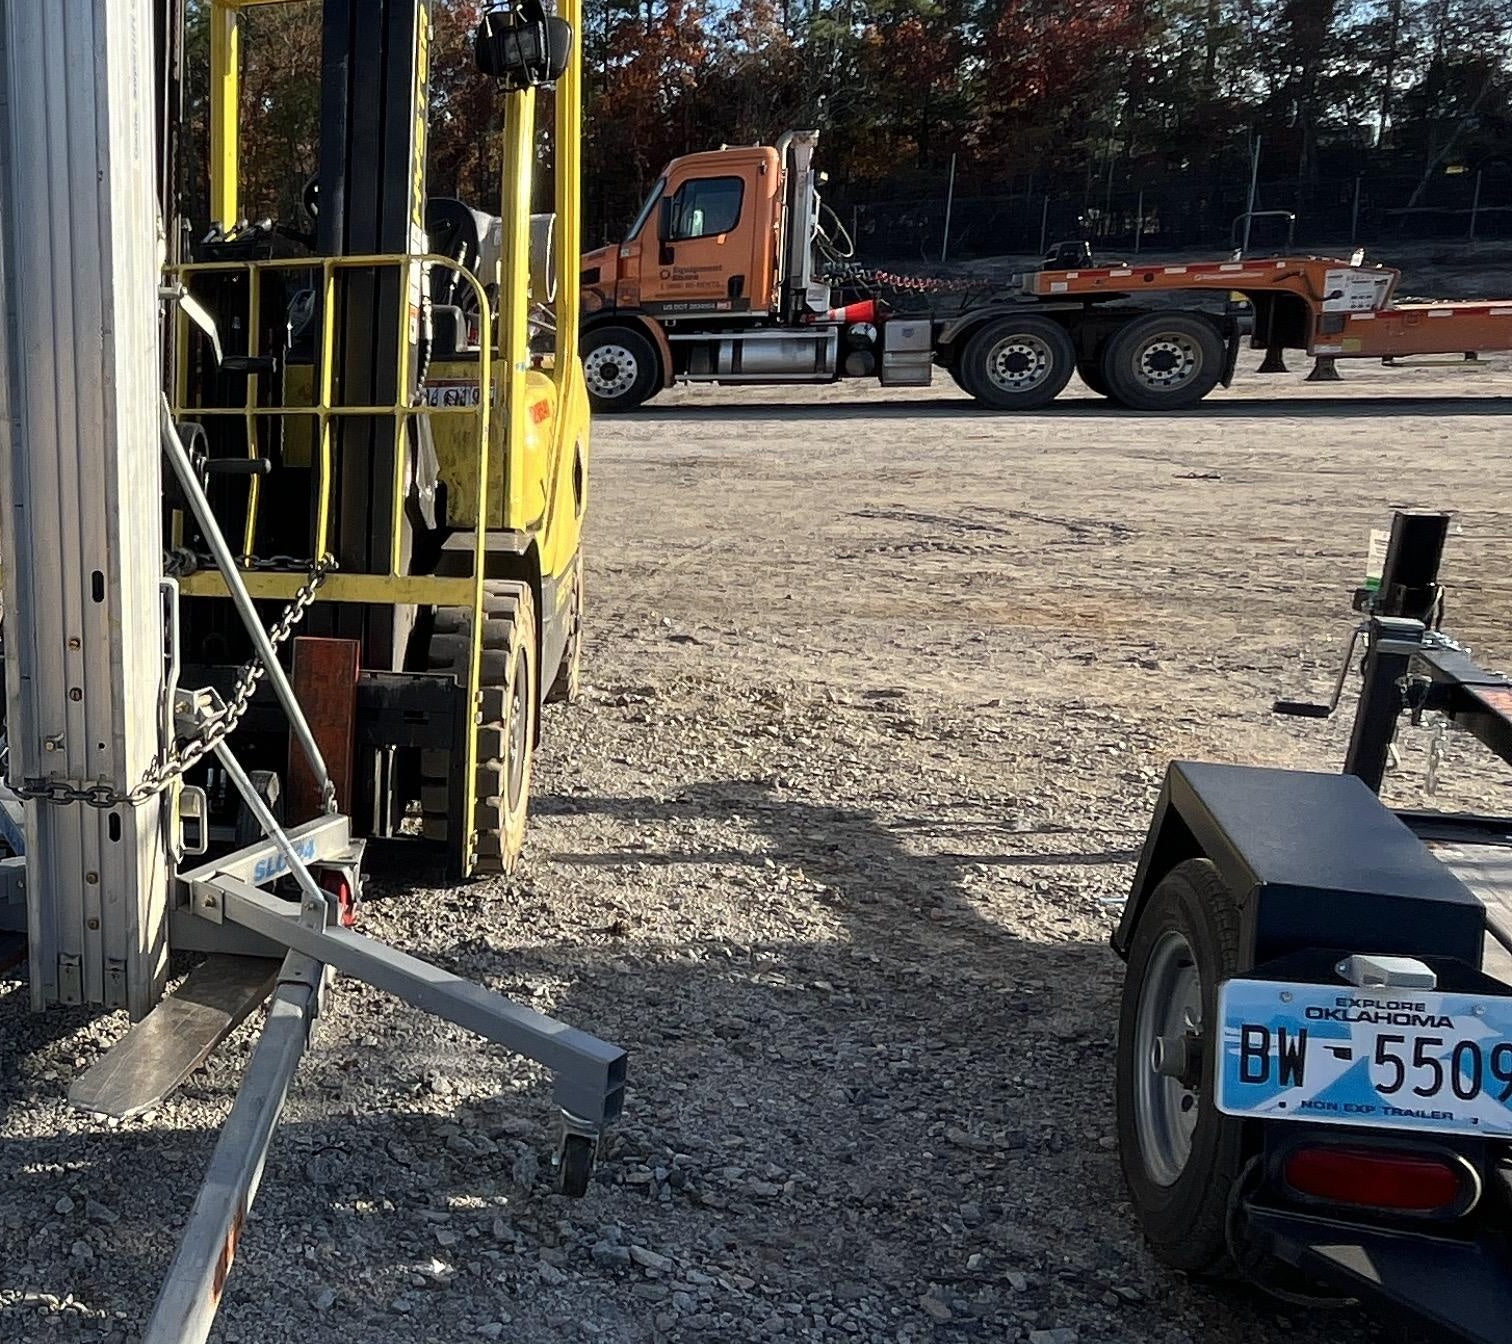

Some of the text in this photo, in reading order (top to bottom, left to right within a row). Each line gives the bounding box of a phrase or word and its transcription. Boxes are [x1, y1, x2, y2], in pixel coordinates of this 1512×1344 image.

[1335, 997, 1426, 1013] EXPLORE
[1304, 1006, 1455, 1030] OKLAHOMA
[1239, 1023, 1512, 1103] BW 5509
[1300, 1099, 1455, 1121] NON EXP TRAILER
